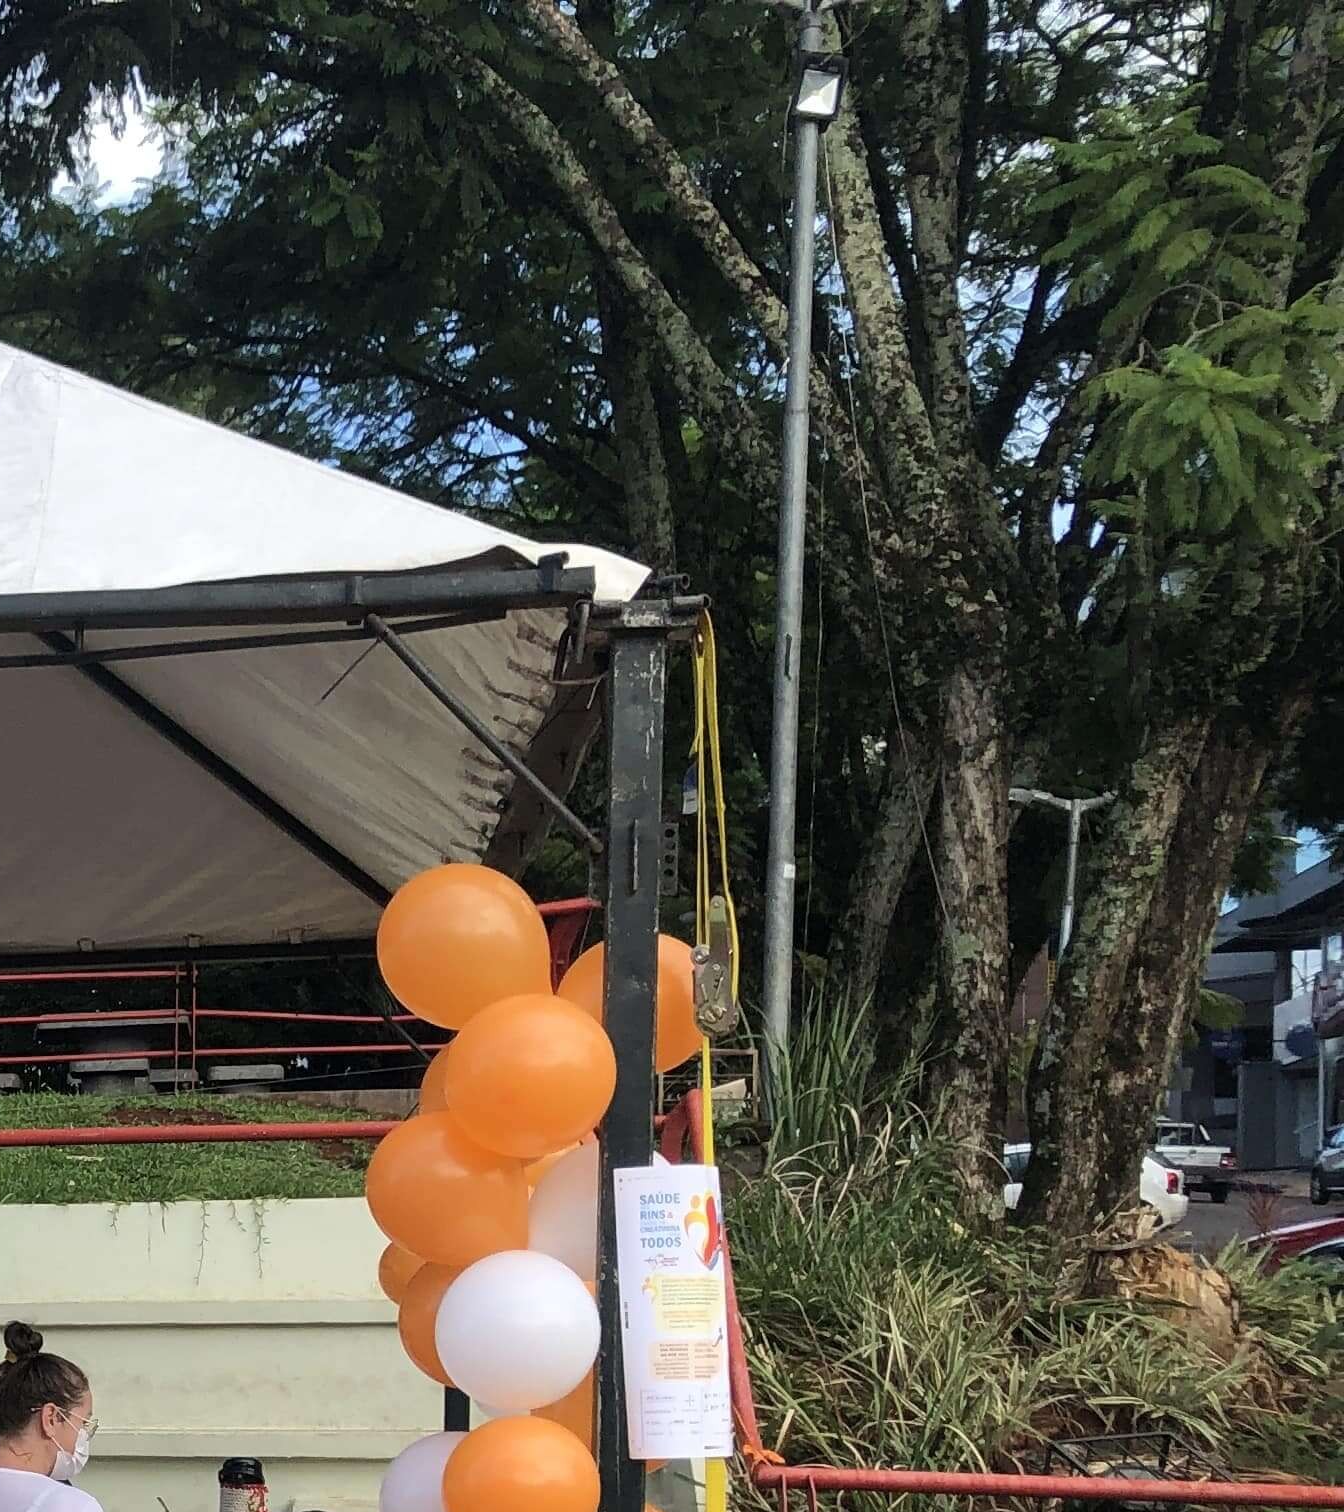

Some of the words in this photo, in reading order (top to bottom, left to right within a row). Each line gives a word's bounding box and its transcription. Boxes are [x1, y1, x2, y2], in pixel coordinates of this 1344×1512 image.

[639, 1191, 681, 1206] SAÚDE
[640, 1209, 666, 1220] RINS
[640, 1236, 682, 1249] TODOS
